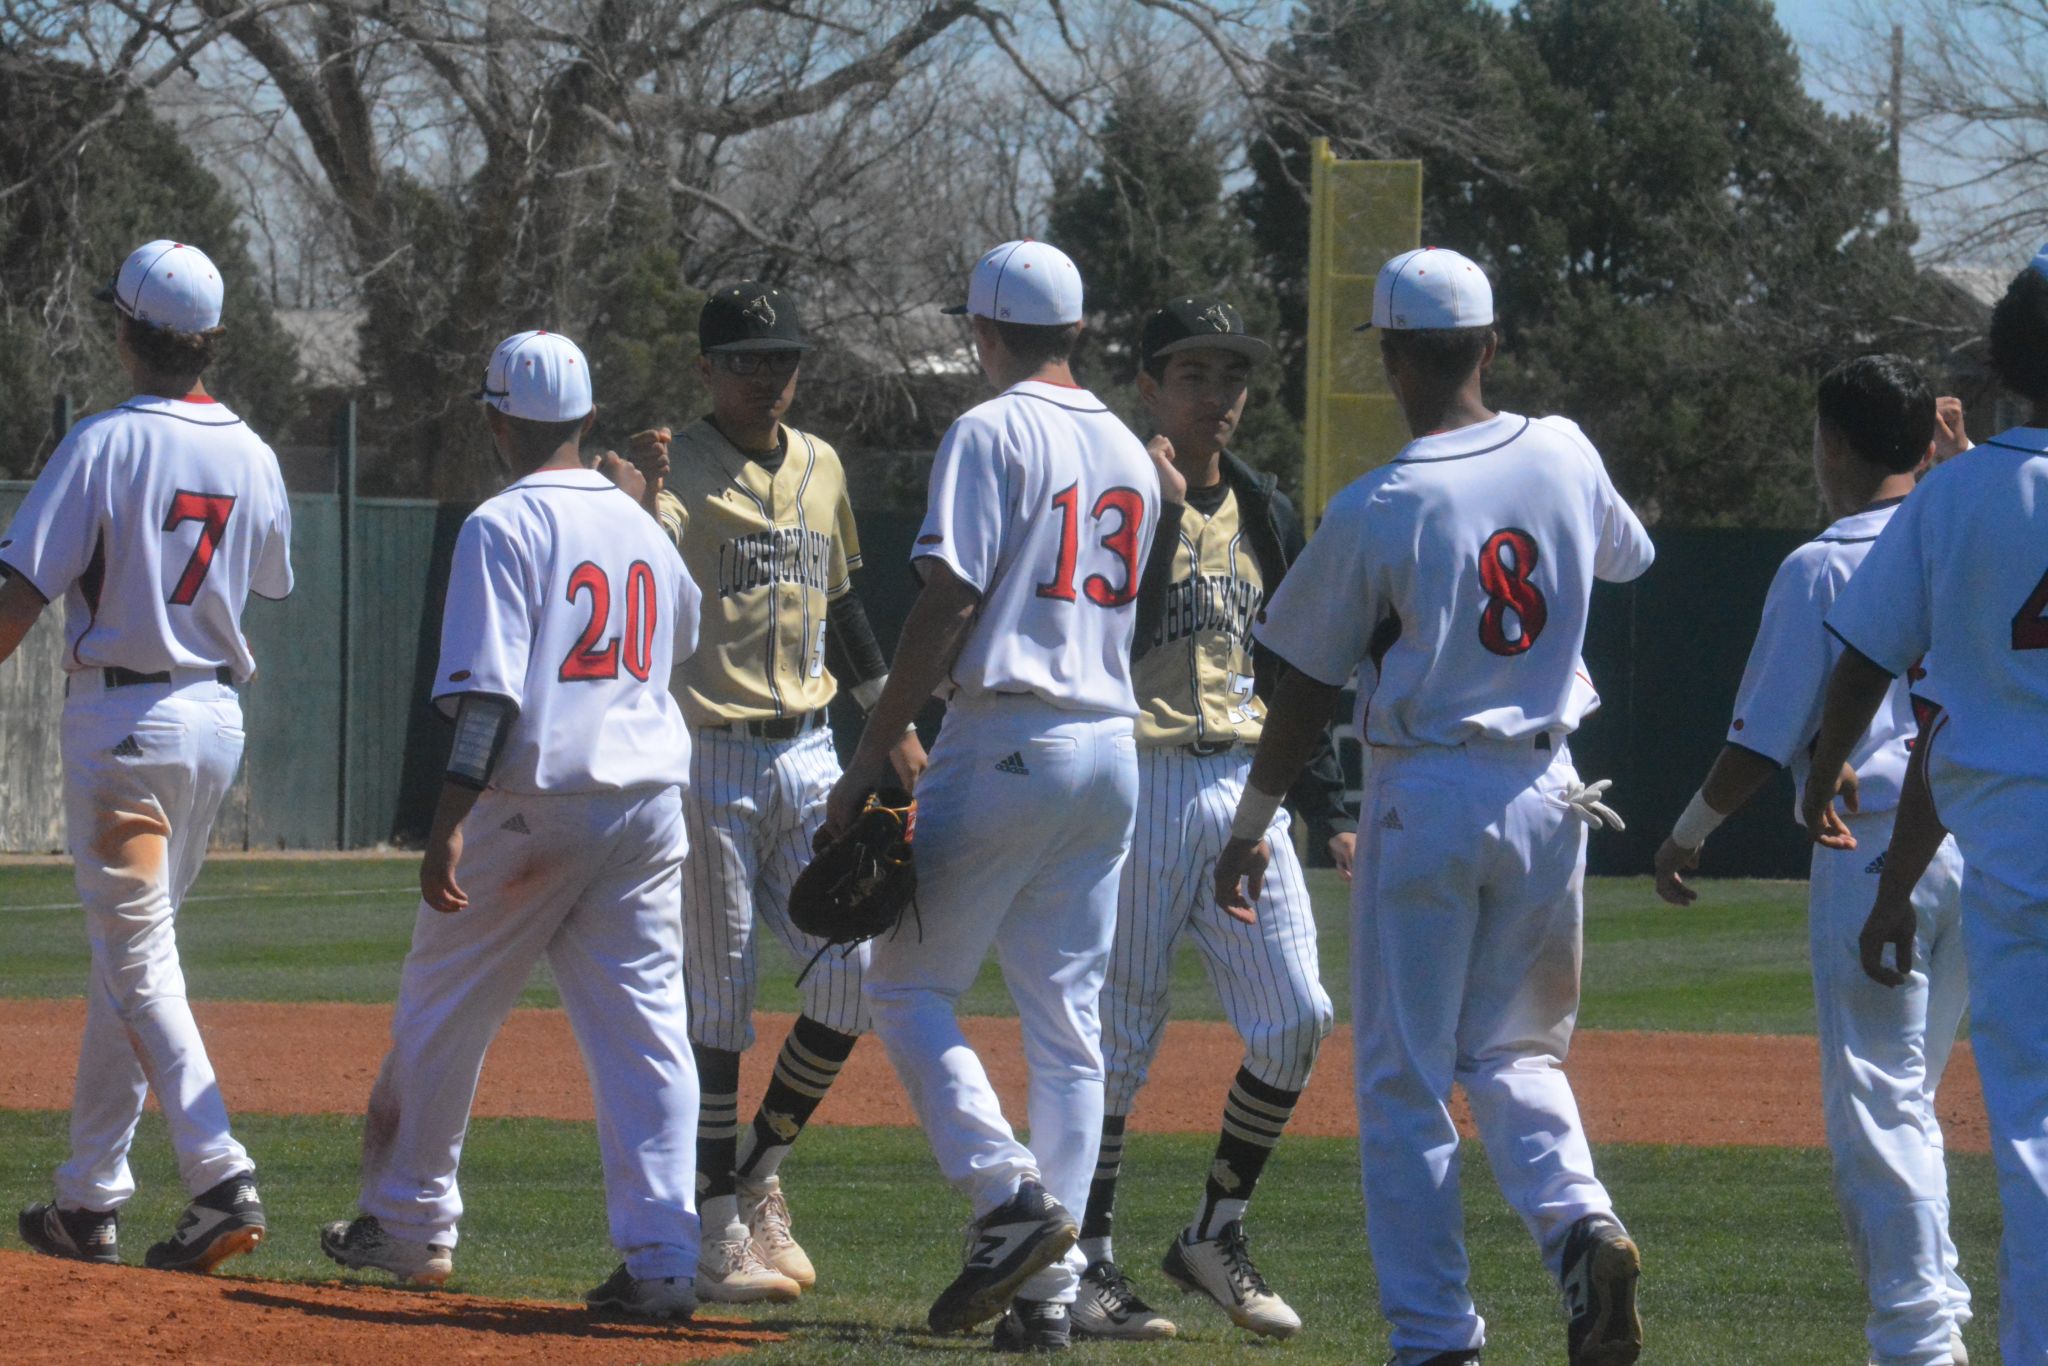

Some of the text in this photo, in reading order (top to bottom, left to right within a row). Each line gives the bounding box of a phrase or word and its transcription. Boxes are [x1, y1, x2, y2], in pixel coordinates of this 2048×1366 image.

[161, 488, 238, 606] 7
[719, 528, 806, 599] LUBBOCK
[1036, 478, 1145, 608] 13
[1478, 527, 1548, 656] 8
[558, 560, 657, 683] 20
